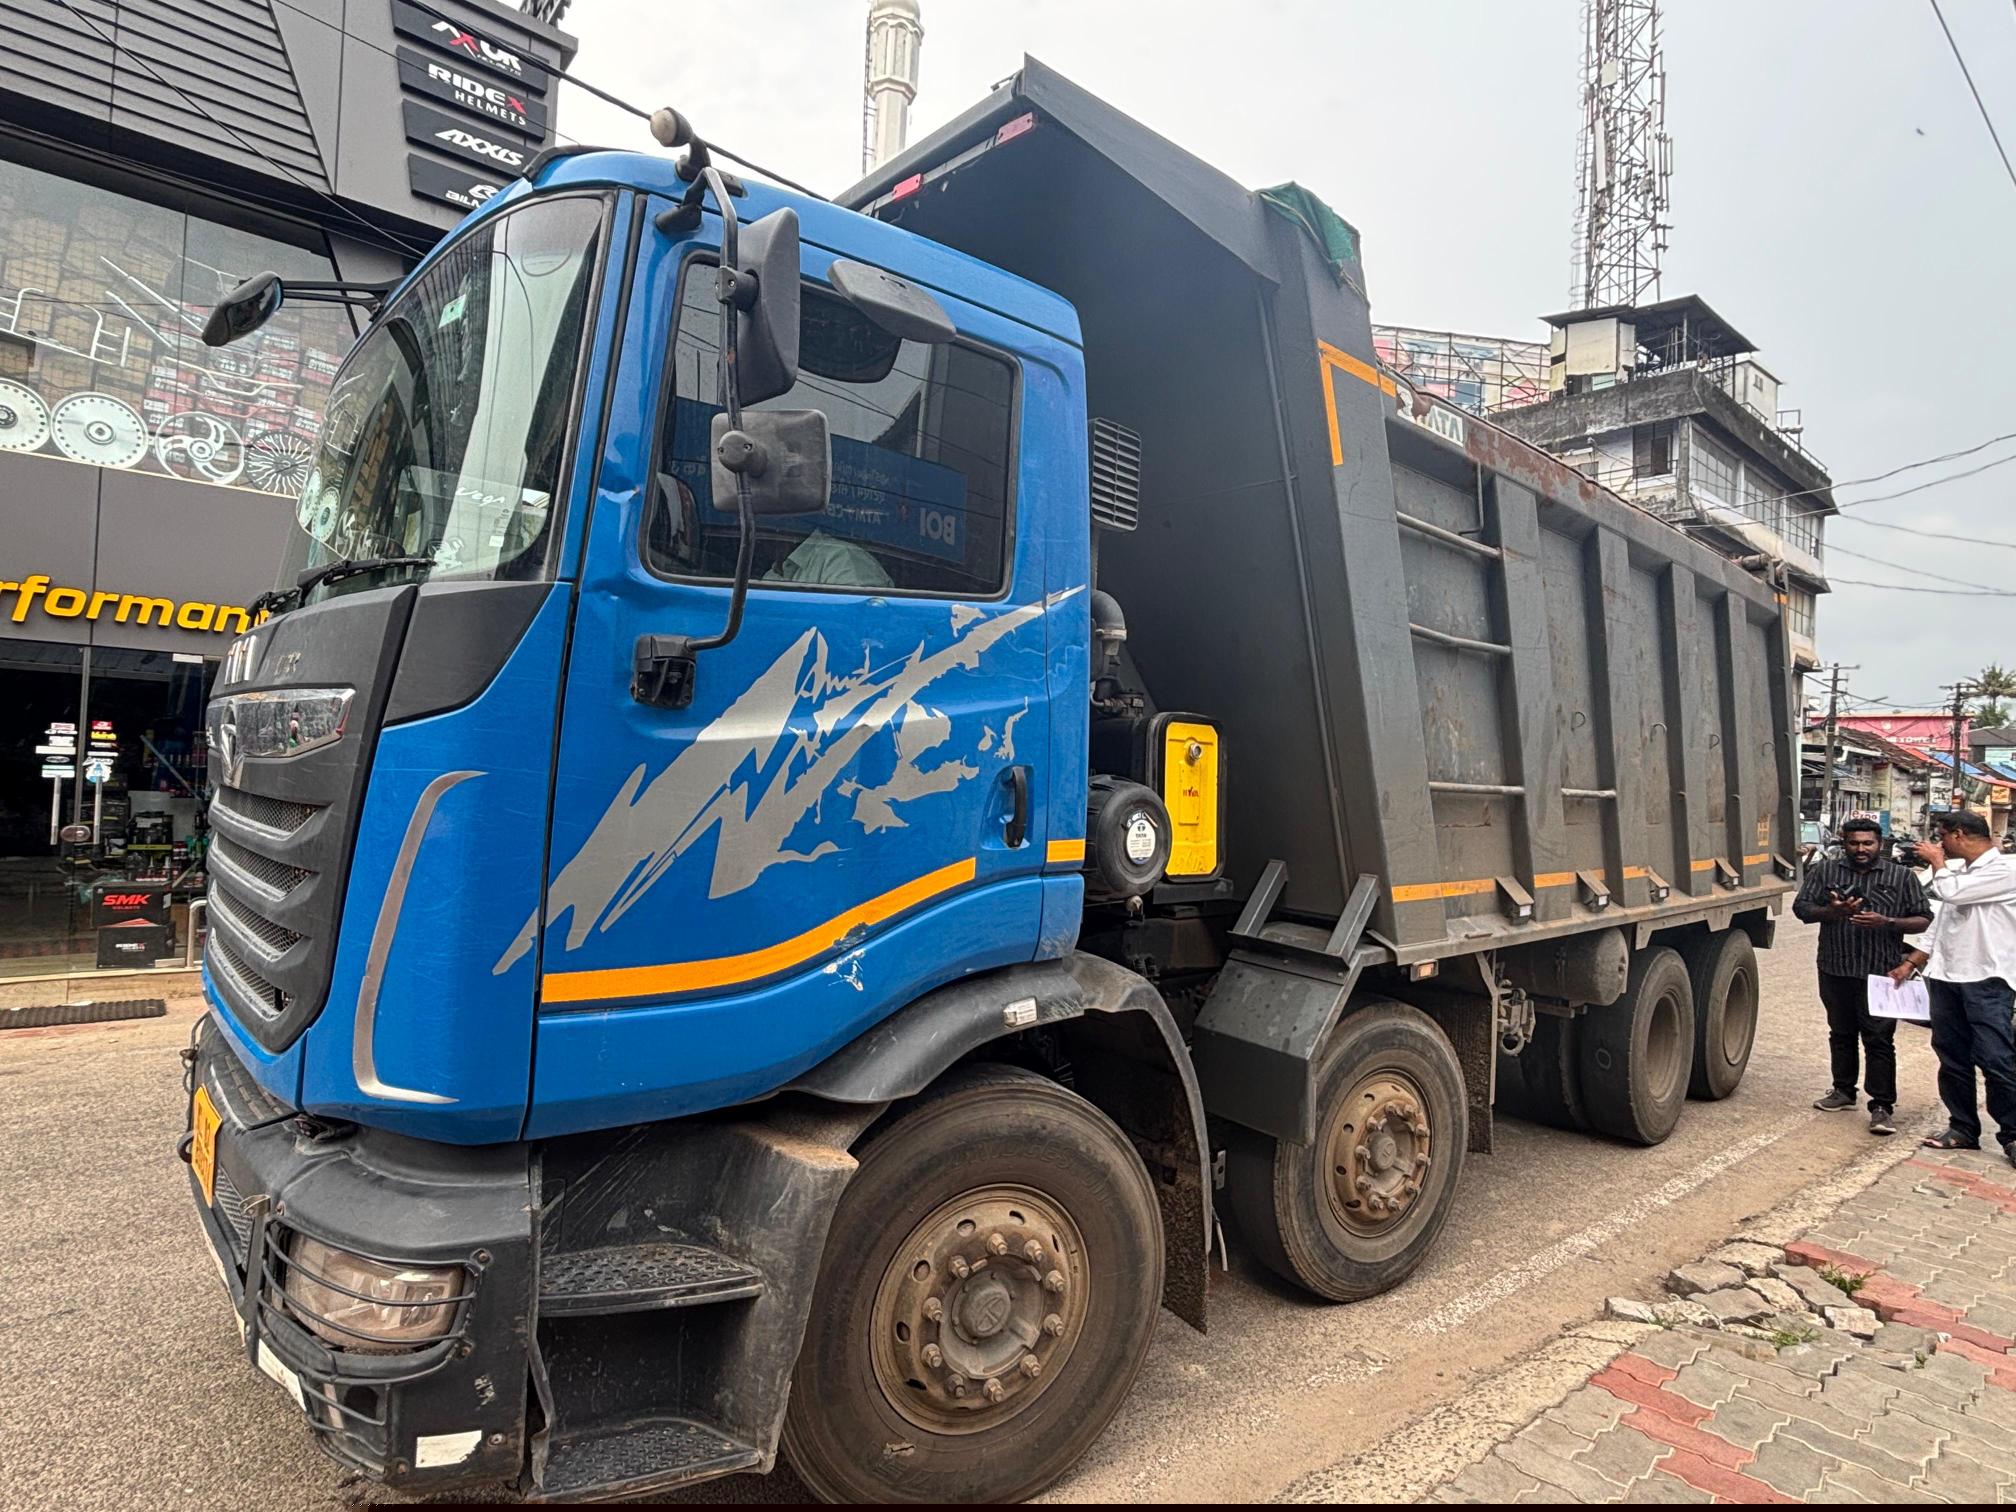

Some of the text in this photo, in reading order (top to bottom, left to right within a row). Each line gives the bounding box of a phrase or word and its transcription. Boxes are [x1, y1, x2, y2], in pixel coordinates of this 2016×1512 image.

[454, 90, 526, 125] HELMETS
[435, 129, 524, 165] AXXIS
[102, 894, 151, 906] SMK
